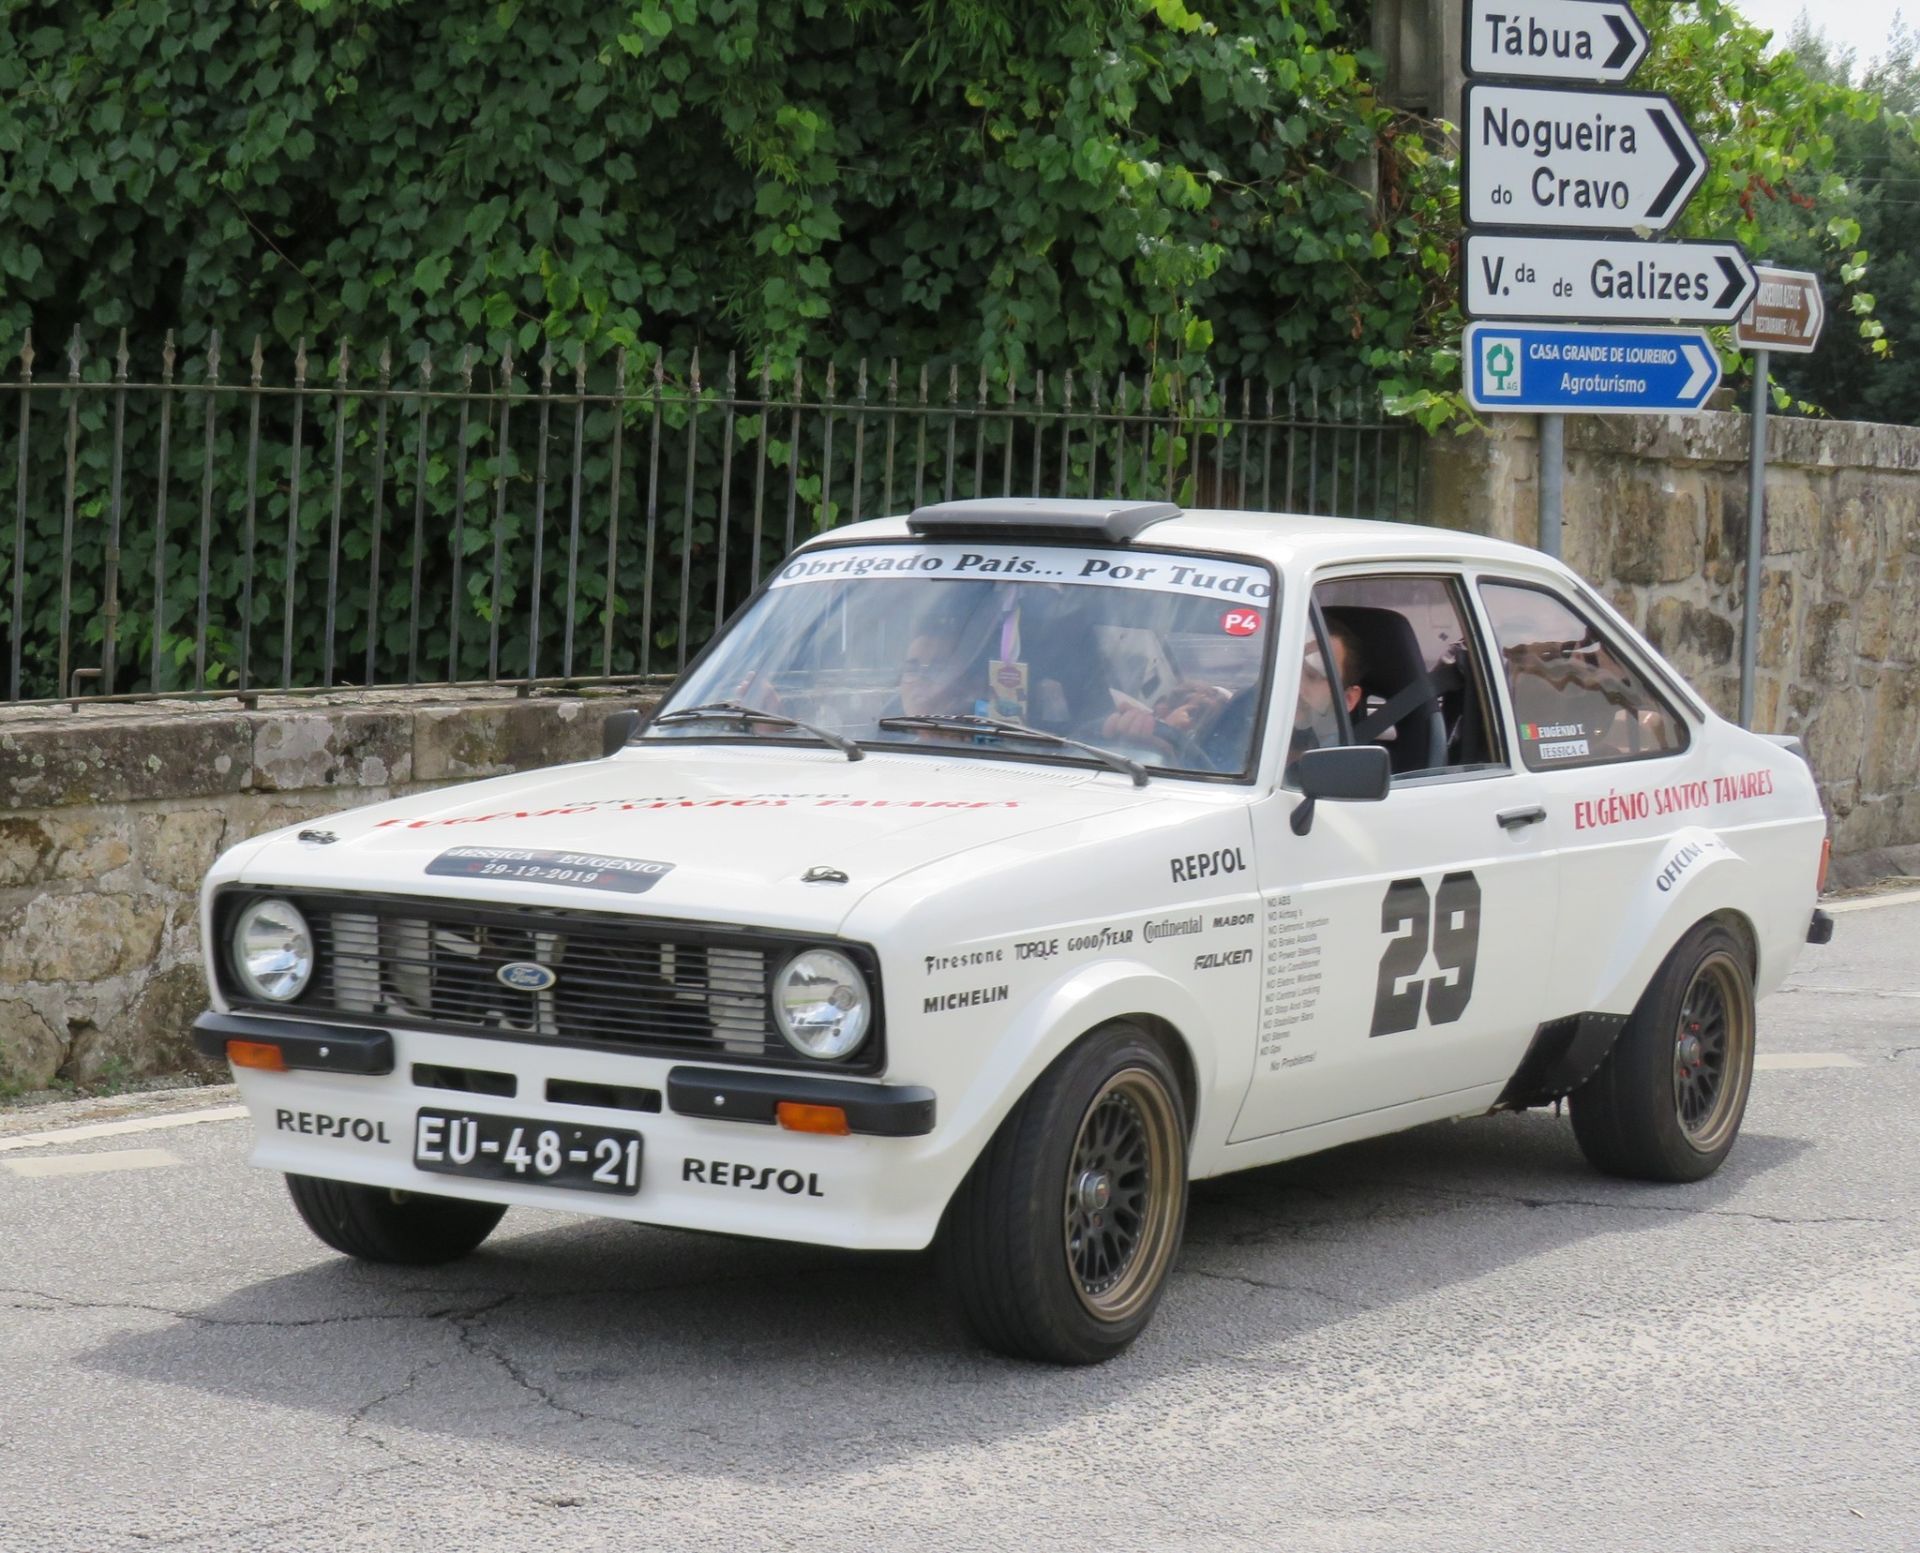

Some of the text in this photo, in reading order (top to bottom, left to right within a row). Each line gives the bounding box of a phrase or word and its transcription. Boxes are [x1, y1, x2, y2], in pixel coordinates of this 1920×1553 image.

[1485, 13, 1593, 60] Tábua
[1483, 106, 1637, 157] Nogueira
[1491, 166, 1630, 209] do Cravo
[1553, 278, 1573, 298] de
[1591, 258, 1709, 301] Galizes
[1529, 344, 1677, 364] CASA GRANDE DE LOUREIRO
[1560, 372, 1646, 394] Agroturismo
[782, 553, 944, 580] Obrigado
[1078, 559, 1158, 581] Por
[1168, 566, 1270, 598] Tudo
[1225, 613, 1257, 631] P4
[1574, 769, 1774, 830] EUGÉNIO SANTOS TAVARES
[479, 863, 599, 883] 29-12-2019
[1170, 847, 1246, 883] REPSOL
[1278, 895, 1291, 905] ABS
[924, 948, 1003, 976] Firestone
[1014, 938, 1059, 960] TORQUE
[1143, 914, 1203, 943] Continental
[1213, 913, 1254, 928] MABOR
[1193, 949, 1253, 970] FALKEN
[1369, 870, 1481, 1038] 29
[923, 984, 1009, 1013] MICHELIN
[276, 1108, 392, 1144] REPSOL
[416, 1114, 639, 1187] EU-48-21
[683, 1157, 825, 1197] REPSOL
